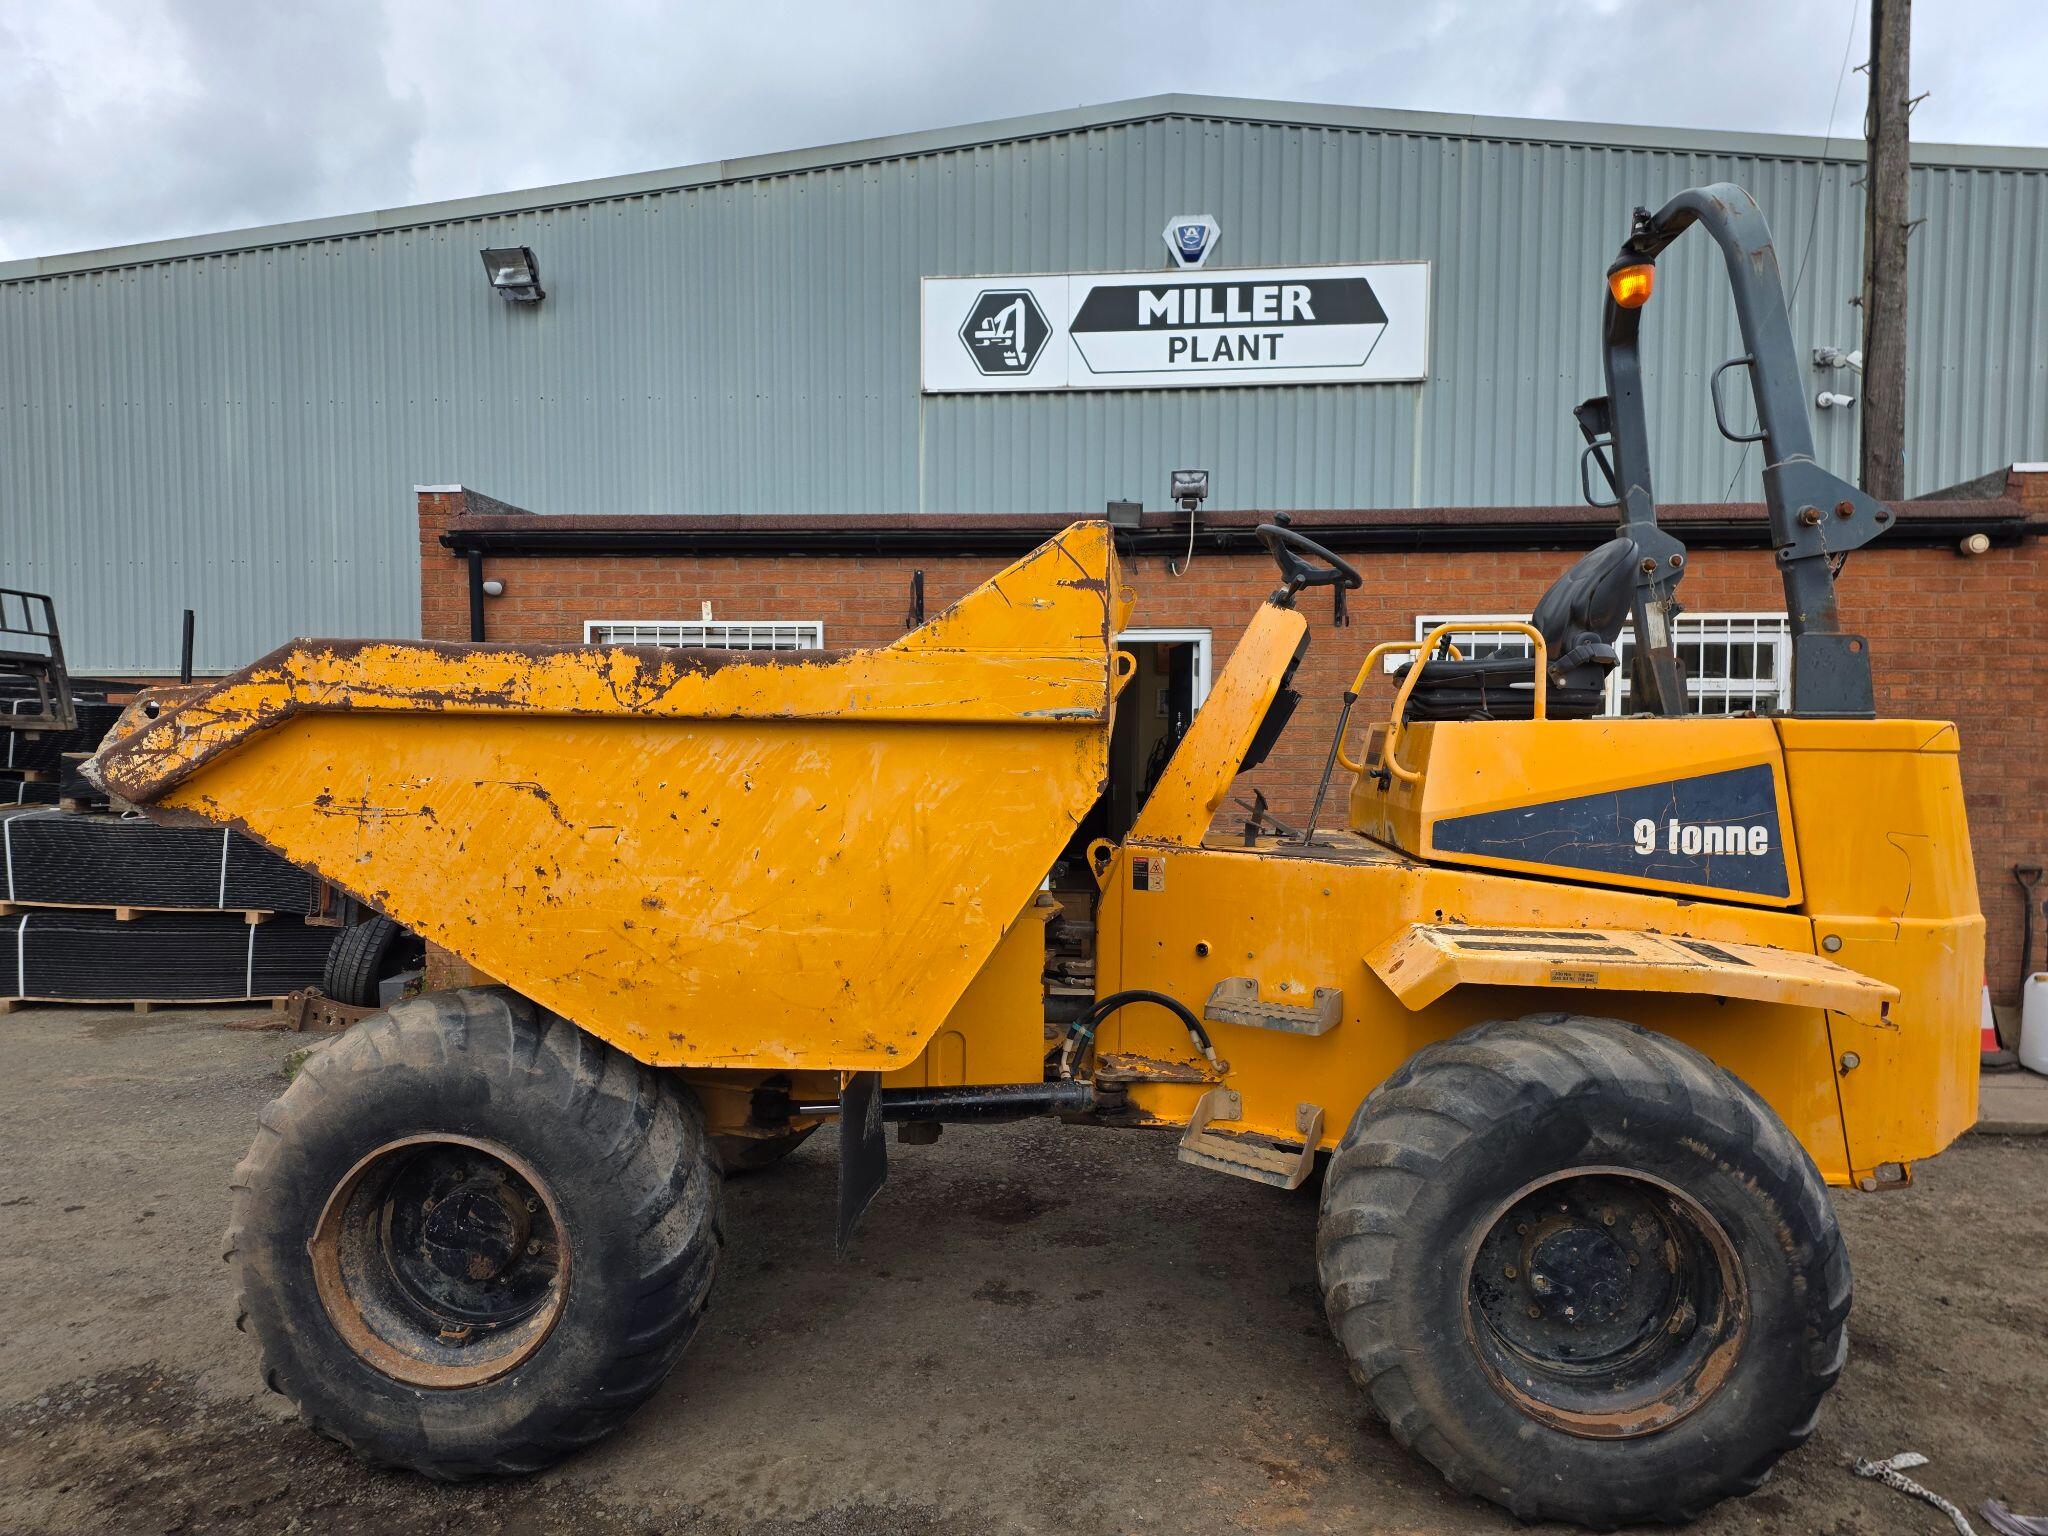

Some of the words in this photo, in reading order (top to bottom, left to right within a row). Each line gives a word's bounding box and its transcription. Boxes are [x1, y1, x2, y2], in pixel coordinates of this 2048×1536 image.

[1138, 285, 1316, 326] MILLER
[1168, 333, 1284, 364] PLANT
[1633, 818, 1656, 855] 9
[1668, 818, 1769, 856] tonne
